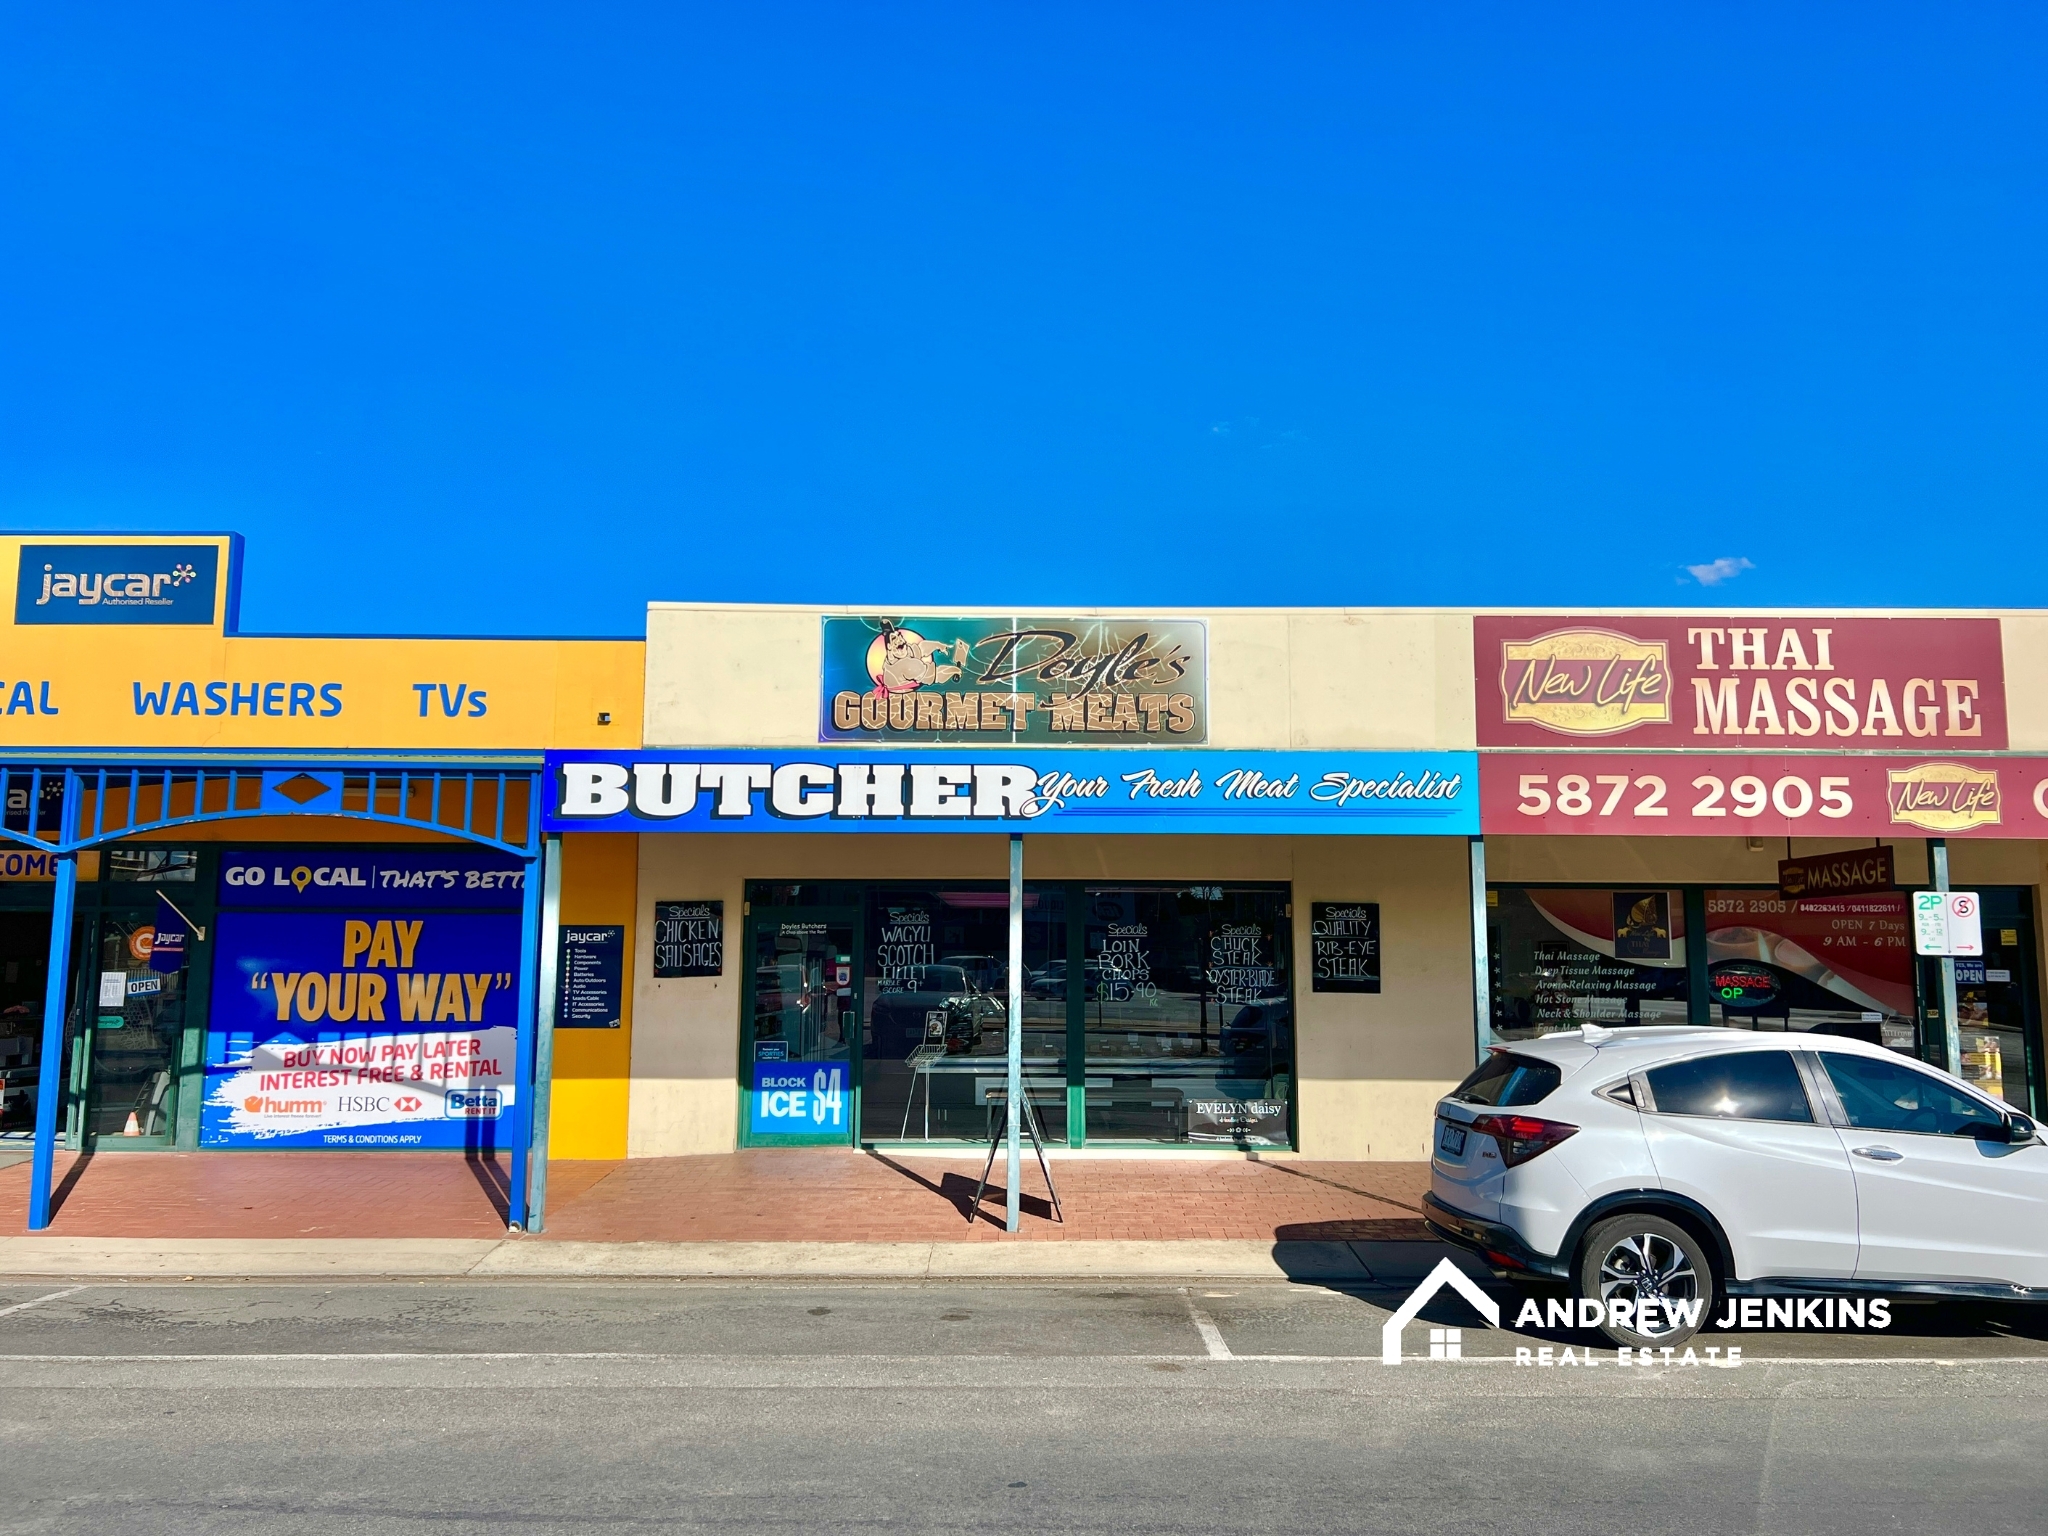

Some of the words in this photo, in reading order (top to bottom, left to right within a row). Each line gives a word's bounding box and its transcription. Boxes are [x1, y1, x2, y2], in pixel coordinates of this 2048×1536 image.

[36, 564, 171, 605] jaycar
[1688, 627, 1836, 671] THAI
[975, 629, 1192, 710] Doyle's
[1510, 656, 1592, 710] New
[1596, 655, 1662, 713] Life
[0, 681, 59, 716] AL
[133, 681, 344, 717] WASHERS
[412, 683, 488, 718] TVs
[831, 692, 1036, 732] GOURMET
[1049, 692, 1196, 732] MEATS
[1691, 677, 1982, 738] MASSAGE
[557, 762, 1039, 819] BUTCHER
[1021, 770, 1110, 818] Your
[1119, 768, 1204, 800] Fresh
[1215, 769, 1300, 801] Meat
[1309, 769, 1463, 807] Specialist
[1517, 774, 1669, 817] 5872
[1691, 775, 1854, 819] 2905
[1893, 778, 1948, 817] New
[1951, 777, 1996, 818] Life
[0, 853, 59, 876] OME
[225, 866, 266, 886] GO
[273, 866, 367, 893] LOCAL
[380, 870, 460, 888] THAT'S
[464, 870, 525, 889] BETT
[1807, 858, 1887, 889] MASSAGE
[1708, 900, 1745, 913] 5872
[1749, 900, 1787, 913] 2905
[1918, 895, 1943, 910] 2P
[669, 904, 710, 918] Specials
[889, 911, 930, 924] Specials
[1325, 906, 1367, 920] Specials
[655, 919, 719, 943] CHICKEN
[881, 925, 931, 943] WAGYU
[1107, 923, 1148, 937] Specials
[1221, 923, 1262, 936] Specials
[1313, 920, 1371, 936] QUALITY
[1831, 919, 1863, 930] OPEN
[1868, 921, 1875, 931] 7
[1879, 921, 1905, 933] Days
[155, 933, 185, 944] Jaycar
[342, 920, 424, 968] PAY
[565, 930, 608, 944] jaycar
[1210, 936, 1262, 954] CHUCK
[1823, 937, 1833, 946] 9
[1836, 936, 1857, 947] AM
[1874, 937, 1882, 946] 6
[1887, 936, 1906, 947] PM
[1101, 939, 1140, 953] LOIN
[1314, 940, 1376, 955] RIB-EYE
[655, 942, 722, 969] SAUSAGES
[877, 944, 934, 967] SCOTCH
[1097, 951, 1151, 970] PORK
[1212, 950, 1262, 966] STEAK
[1533, 951, 1554, 961] Thai
[1556, 952, 1601, 962] Massage
[882, 966, 929, 979] FILLET
[1102, 968, 1150, 980] CHOPS
[1318, 956, 1371, 979] STEAK
[1535, 966, 1559, 976] Deep
[1560, 966, 1590, 975] Tissue
[1591, 966, 1635, 977] Massage
[1955, 969, 1983, 982] OPEN
[131, 980, 158, 993] OPEN
[1535, 980, 1567, 990] Aroma
[1568, 980, 1611, 992] Relaxing
[1613, 981, 1657, 992] Massage
[1715, 975, 1771, 988] MASSAGE
[1215, 985, 1265, 1006] STEAK
[1535, 995, 1553, 1004] Hot
[1555, 995, 1583, 1004] Stone
[1584, 995, 1628, 1006] Massage
[1721, 987, 1743, 999] OP
[1536, 1009, 1562, 1018] Neck
[1563, 1009, 1571, 1018] &
[1572, 1009, 1616, 1019] Shoulder
[1618, 1009, 1662, 1021] Massage
[1537, 1022, 1558, 1032] Foot
[283, 1049, 325, 1069] BUY
[329, 1045, 378, 1065] NOW
[381, 1042, 419, 1062] PAY
[423, 1038, 482, 1059] LATER
[259, 1069, 353, 1092] INTEREST
[357, 1065, 405, 1085] FREE
[409, 1064, 424, 1082] &
[429, 1058, 502, 1080] RENTAL
[761, 1077, 807, 1088] BLOCK
[264, 1096, 323, 1113] humm
[337, 1096, 390, 1113] HSBC
[450, 1093, 498, 1110] Betta
[760, 1090, 807, 1118] ICE
[812, 1068, 843, 1125] $4
[464, 1107, 487, 1116] RENT
[488, 1107, 497, 1116] IT
[1196, 1102, 1248, 1114] EVELYN
[1250, 1102, 1282, 1116] daisy
[323, 1135, 347, 1144] TERMS
[348, 1135, 354, 1144] &
[354, 1135, 397, 1144] CONDITIONS
[399, 1135, 422, 1144] APPLY
